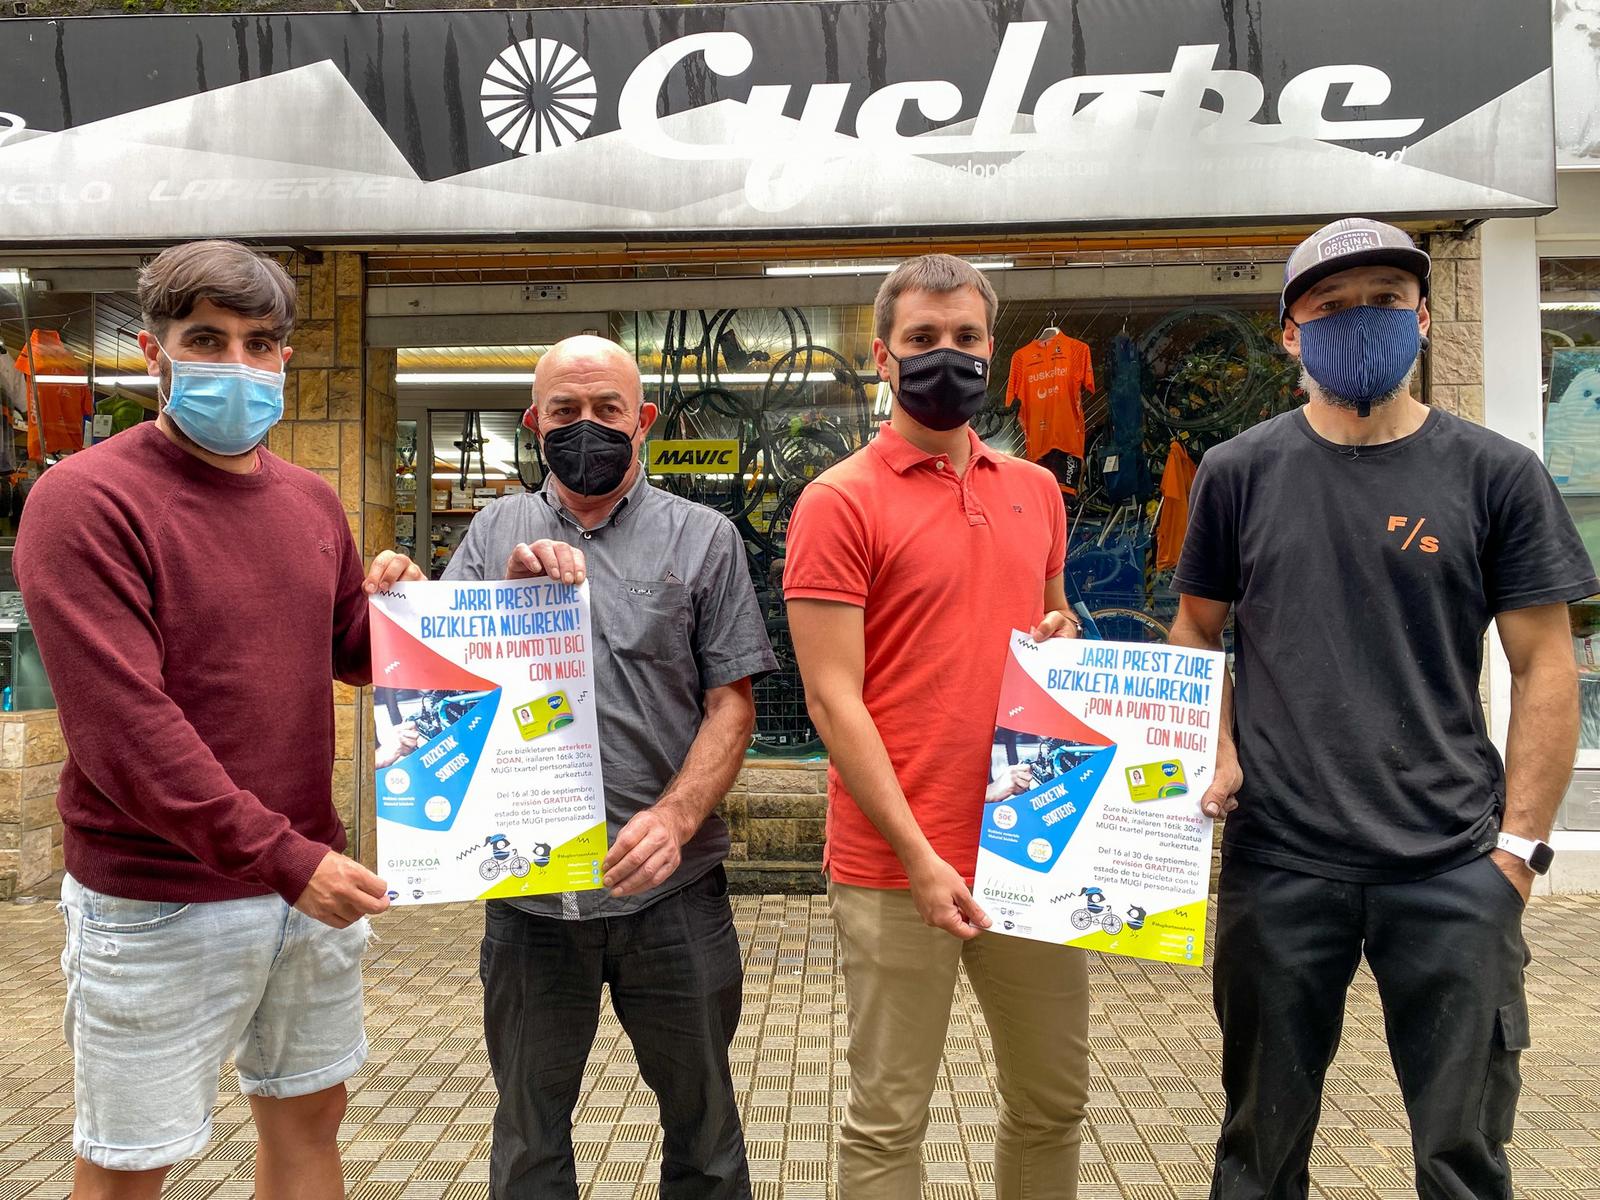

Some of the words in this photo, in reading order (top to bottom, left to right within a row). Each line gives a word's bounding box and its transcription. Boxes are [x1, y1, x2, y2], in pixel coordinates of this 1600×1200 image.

[618, 21, 1424, 212] Cyclope
[1324, 236, 1376, 255] ORIGINAL
[1028, 366, 1068, 383] euskaltel
[654, 450, 733, 465] MAVIC
[449, 588, 491, 611] JARRI
[496, 585, 542, 610] PREST
[544, 583, 580, 605] ZURE
[421, 615, 496, 639] BIZIKLETA
[501, 608, 581, 637] MUGIREKIN!
[464, 641, 492, 665] ¡PON
[496, 641, 504, 659] A
[507, 638, 543, 658] PUNTO
[545, 637, 561, 656] TU
[564, 634, 585, 654] BICI
[529, 662, 552, 682] CON
[555, 660, 586, 680] MUGI!
[1077, 647, 1118, 669] JARRI
[1122, 650, 1171, 673] PREST
[1174, 653, 1215, 680] ZURE
[1047, 668, 1119, 695] BIZIKLETA
[1123, 675, 1210, 706] MUGIREKIN!
[1084, 697, 1112, 718] ¡PON
[1115, 701, 1123, 718] A
[1126, 702, 1165, 722] PUNTO
[1169, 705, 1185, 724] TU
[1187, 708, 1210, 729] BICI
[1146, 726, 1170, 747] CON
[1173, 730, 1207, 753] MUGI!
[496, 748, 513, 756] Zure
[514, 746, 556, 755] bizikletaren
[558, 743, 592, 752] azterketa
[525, 755, 554, 763] irailaren
[491, 766, 513, 774] MUGI
[514, 764, 538, 773] txartel
[539, 761, 593, 773] pertsonalizatua
[496, 791, 510, 799] Del
[521, 789, 529, 797] al
[530, 789, 540, 797] 30
[541, 788, 551, 796] de
[543, 795, 582, 805] GRATUITA
[1029, 782, 1069, 811] ZOZKETAK
[494, 809, 519, 818] estado
[521, 808, 531, 816] de
[541, 805, 572, 814] bicicleta
[1041, 801, 1077, 827] SORTEOS
[1103, 804, 1120, 812] Zure
[1121, 806, 1165, 819] bizikletaren
[1166, 813, 1204, 825] azterketa
[496, 820, 520, 829] tarjeta
[522, 817, 543, 825] MUGI
[1102, 813, 1129, 824] DOAN,
[1131, 817, 1161, 828] irailaren
[1164, 821, 1182, 830] 16tik
[1095, 821, 1118, 831] MUGI
[1119, 825, 1144, 835] txartel
[1144, 829, 1202, 843] pertsonalizatua
[1098, 846, 1111, 855] Del
[1113, 849, 1122, 857] 16
[1123, 850, 1131, 858] al
[1132, 852, 1142, 860] 30
[1143, 853, 1153, 861] de
[1159, 840, 1201, 852] aurkeztuta.
[387, 858, 441, 868] GIPUZKOA
[1112, 858, 1143, 869] revisión
[1144, 862, 1185, 875] GRATUITA
[1187, 868, 1200, 877] del
[1093, 865, 1119, 875] estado
[1120, 868, 1131, 876] de
[1132, 870, 1140, 878] tu
[1141, 872, 1173, 883] bicicleta
[1174, 877, 1189, 886] con
[1190, 878, 1199, 886] tu
[1094, 874, 1119, 884] tarjeta
[1120, 877, 1142, 887] MUGI
[983, 887, 1035, 903] GIPUZKOA
